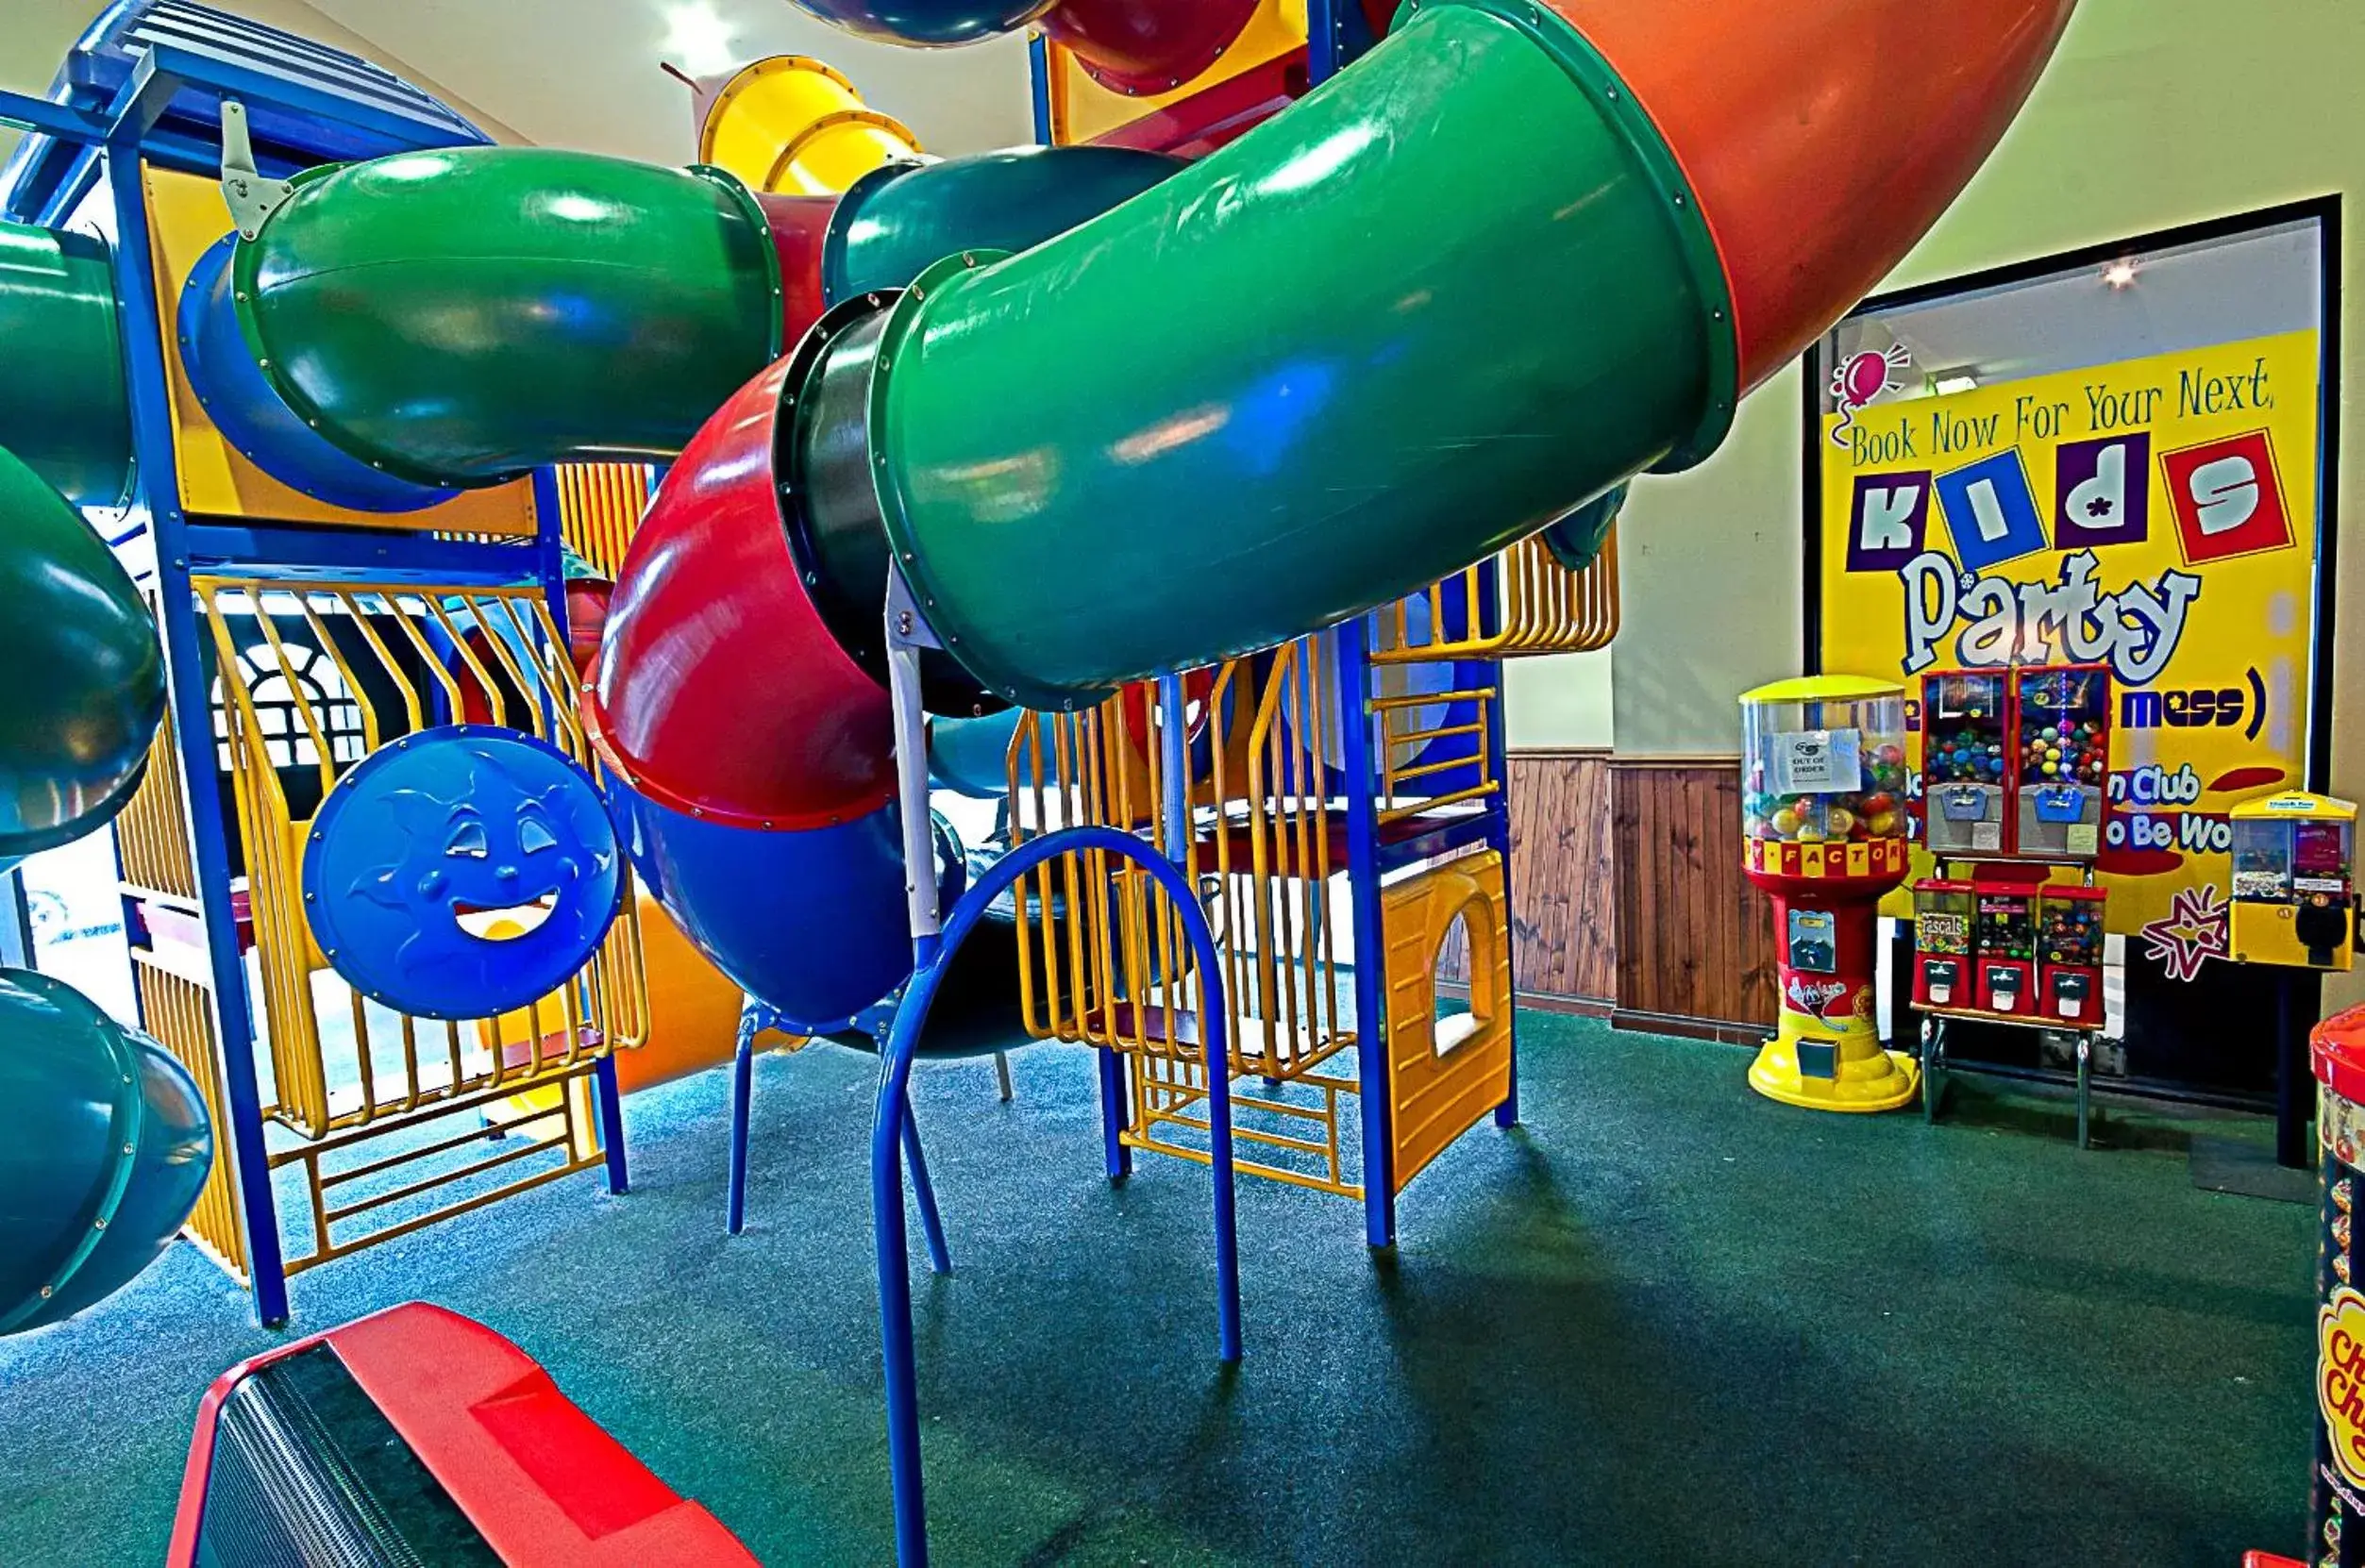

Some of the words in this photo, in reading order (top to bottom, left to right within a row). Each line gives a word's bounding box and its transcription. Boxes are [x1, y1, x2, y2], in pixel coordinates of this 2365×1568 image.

[1853, 418, 1918, 467] Book
[1932, 409, 2000, 455] Now
[2014, 395, 2070, 441] For
[2084, 383, 2163, 431] Your
[1898, 548, 2202, 687] Party
[2131, 763, 2201, 803] Club
[2130, 812, 2173, 848] Be
[2331, 1329, 2365, 1385] Ch
